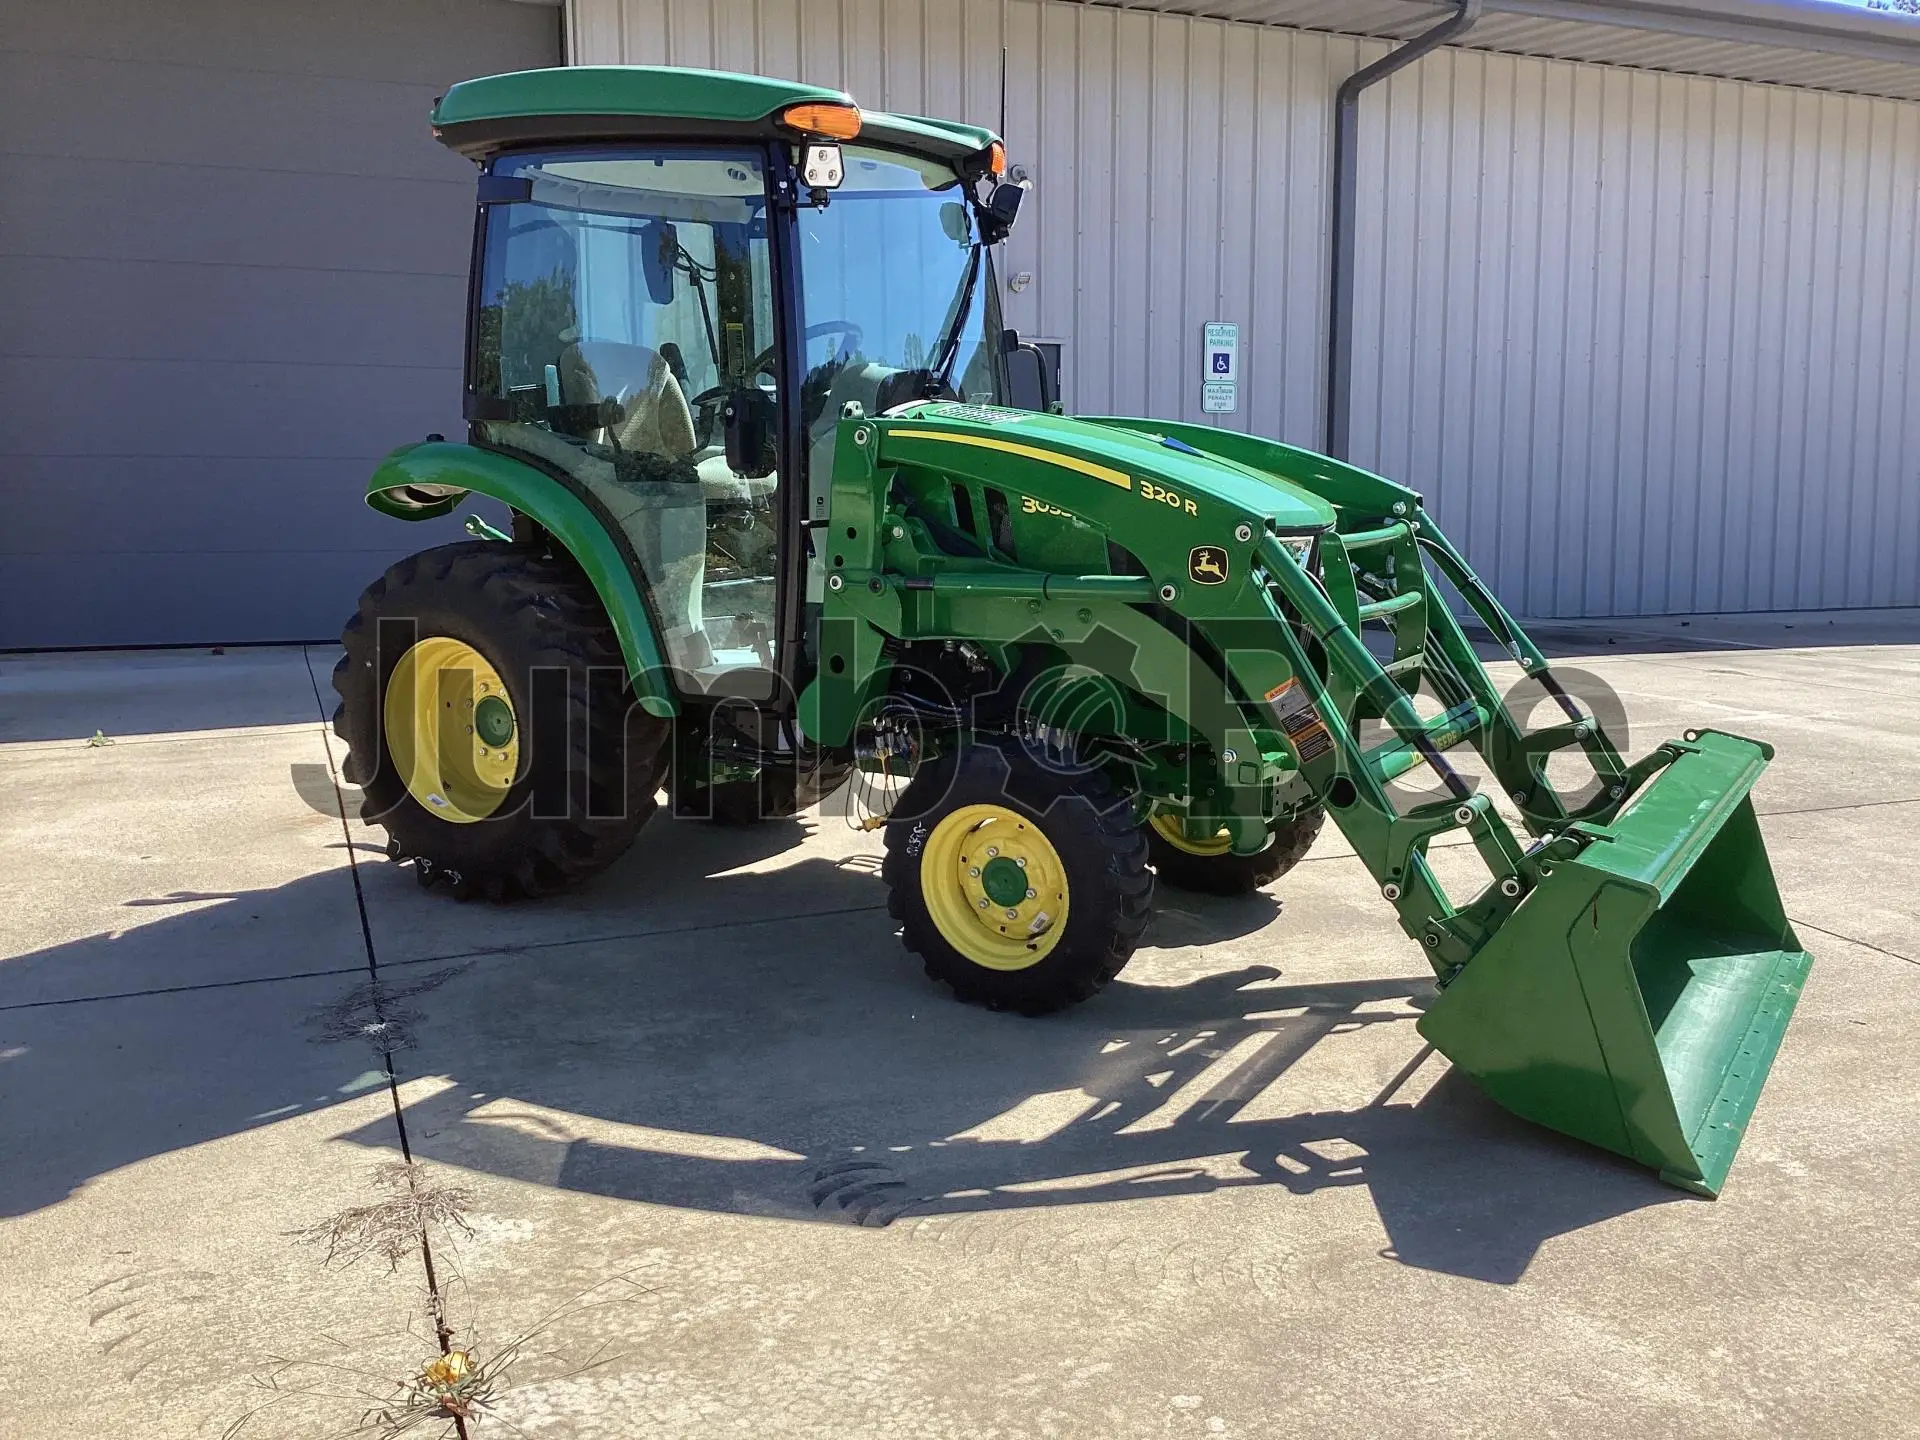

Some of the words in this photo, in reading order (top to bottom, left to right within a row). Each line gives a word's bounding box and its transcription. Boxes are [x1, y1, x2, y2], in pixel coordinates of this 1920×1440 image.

[1207, 328, 1236, 337] RESERVED
[1209, 338, 1234, 347] PARKING
[1140, 480, 1181, 508] 320
[1184, 498, 1198, 517] R
